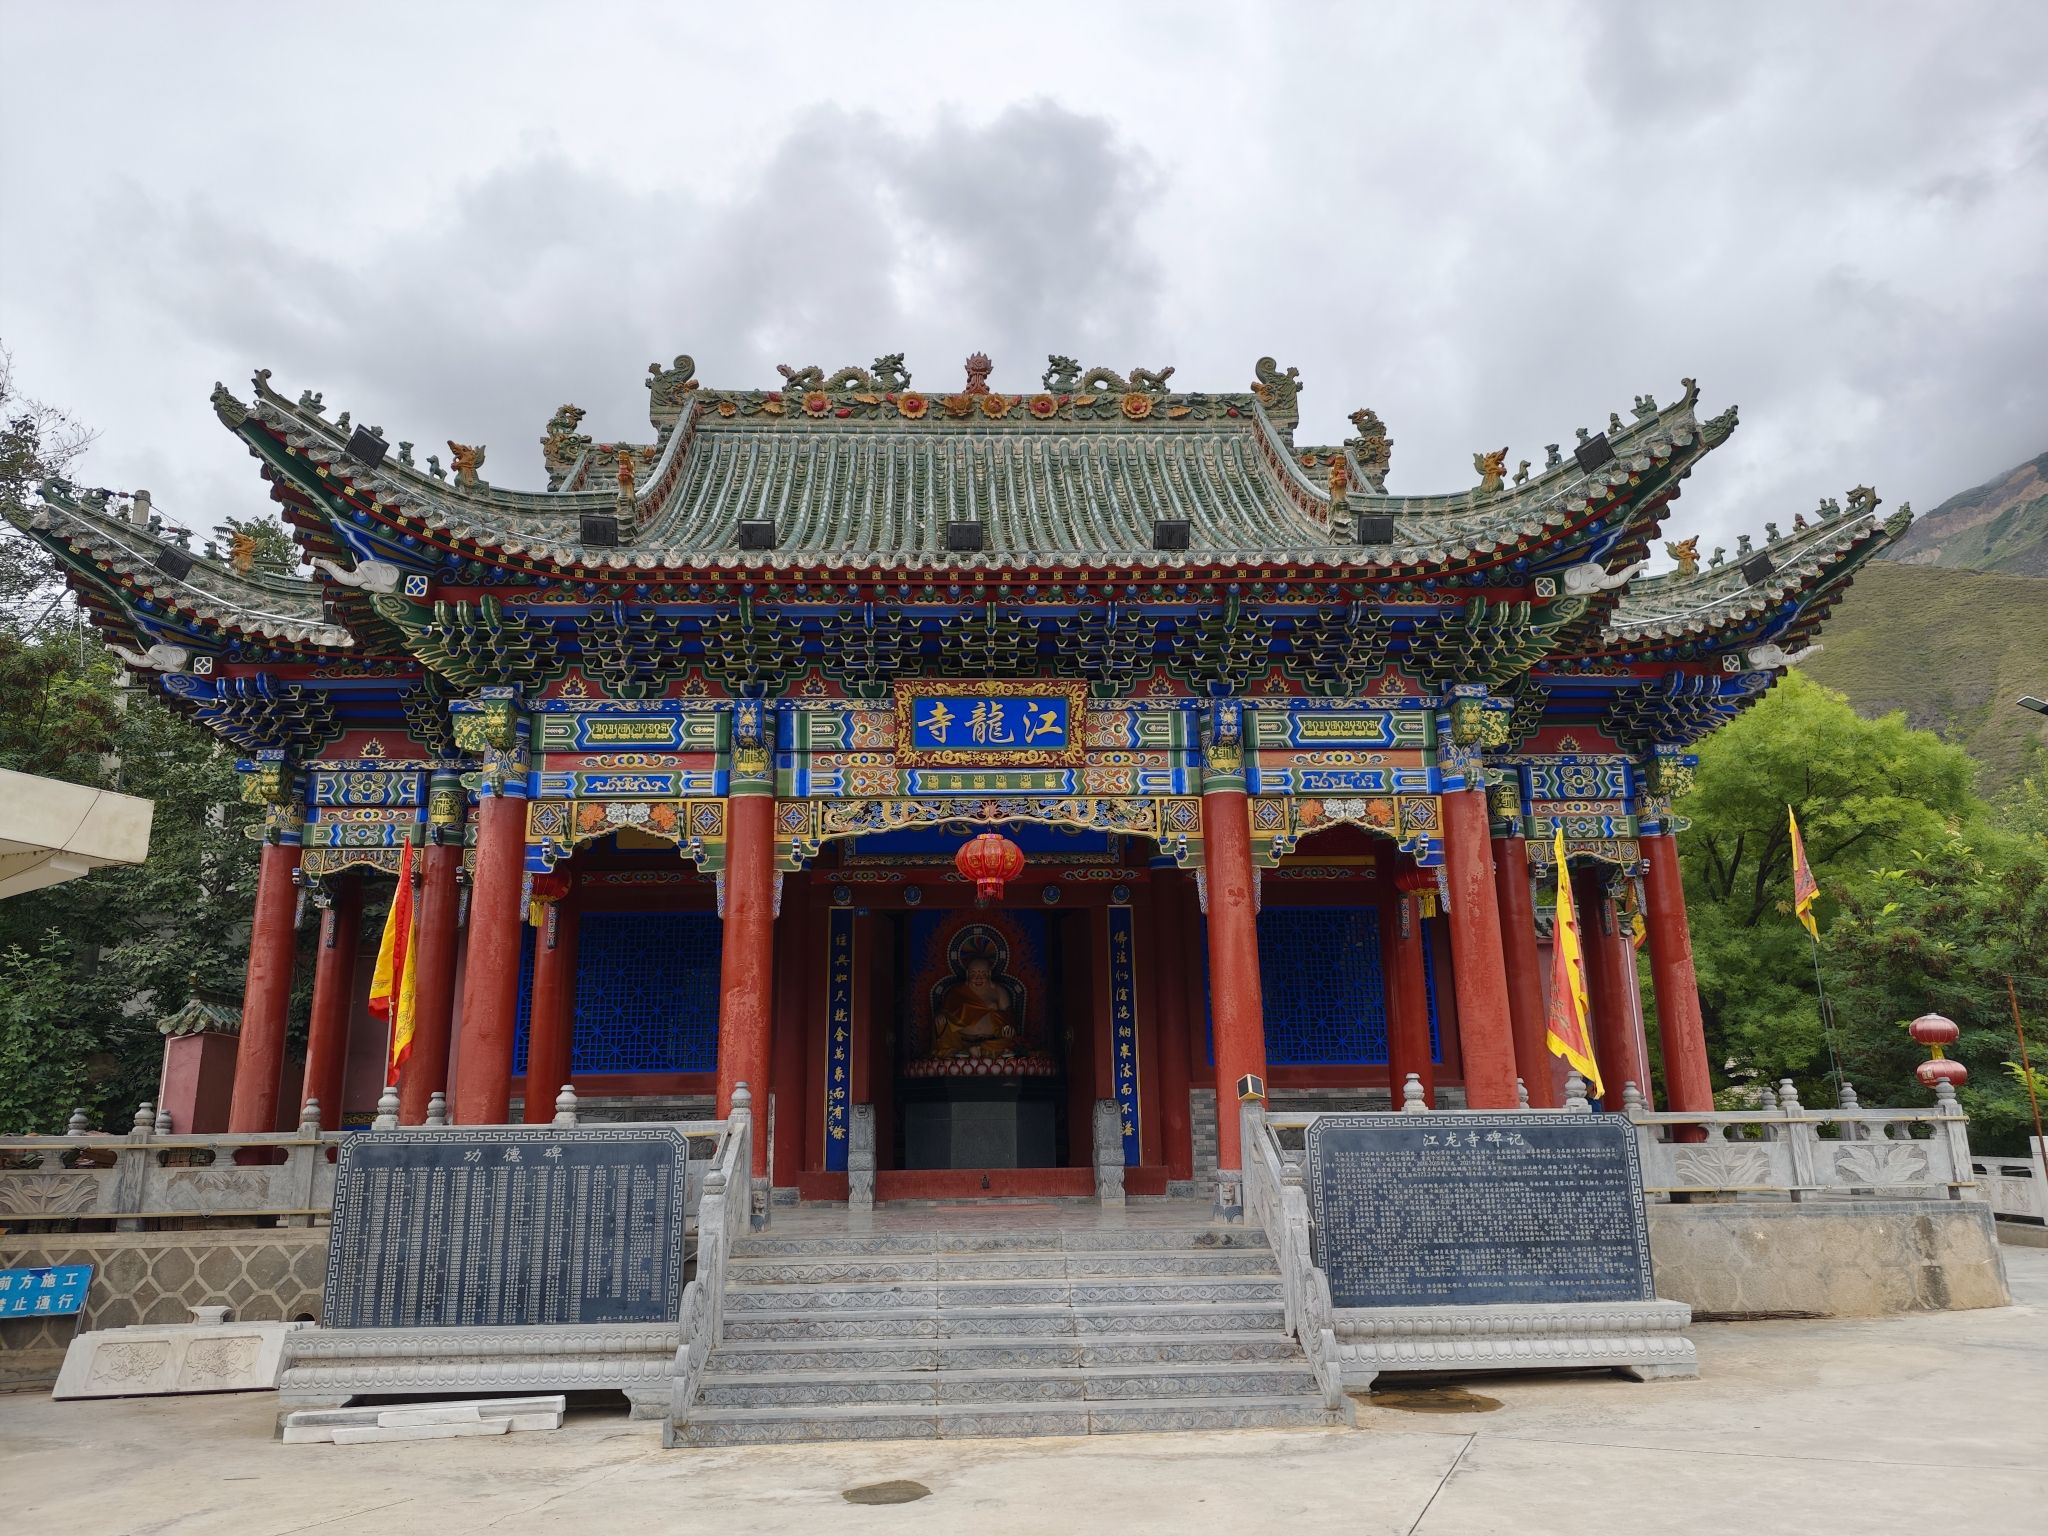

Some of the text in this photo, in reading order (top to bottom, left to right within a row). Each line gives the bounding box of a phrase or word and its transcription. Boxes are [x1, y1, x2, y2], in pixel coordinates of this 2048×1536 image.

[1422, 1130, 1525, 1148] 江龙寺碑记
[463, 1145, 563, 1164] 功德碑
[0, 1273, 79, 1291] 前方施工
